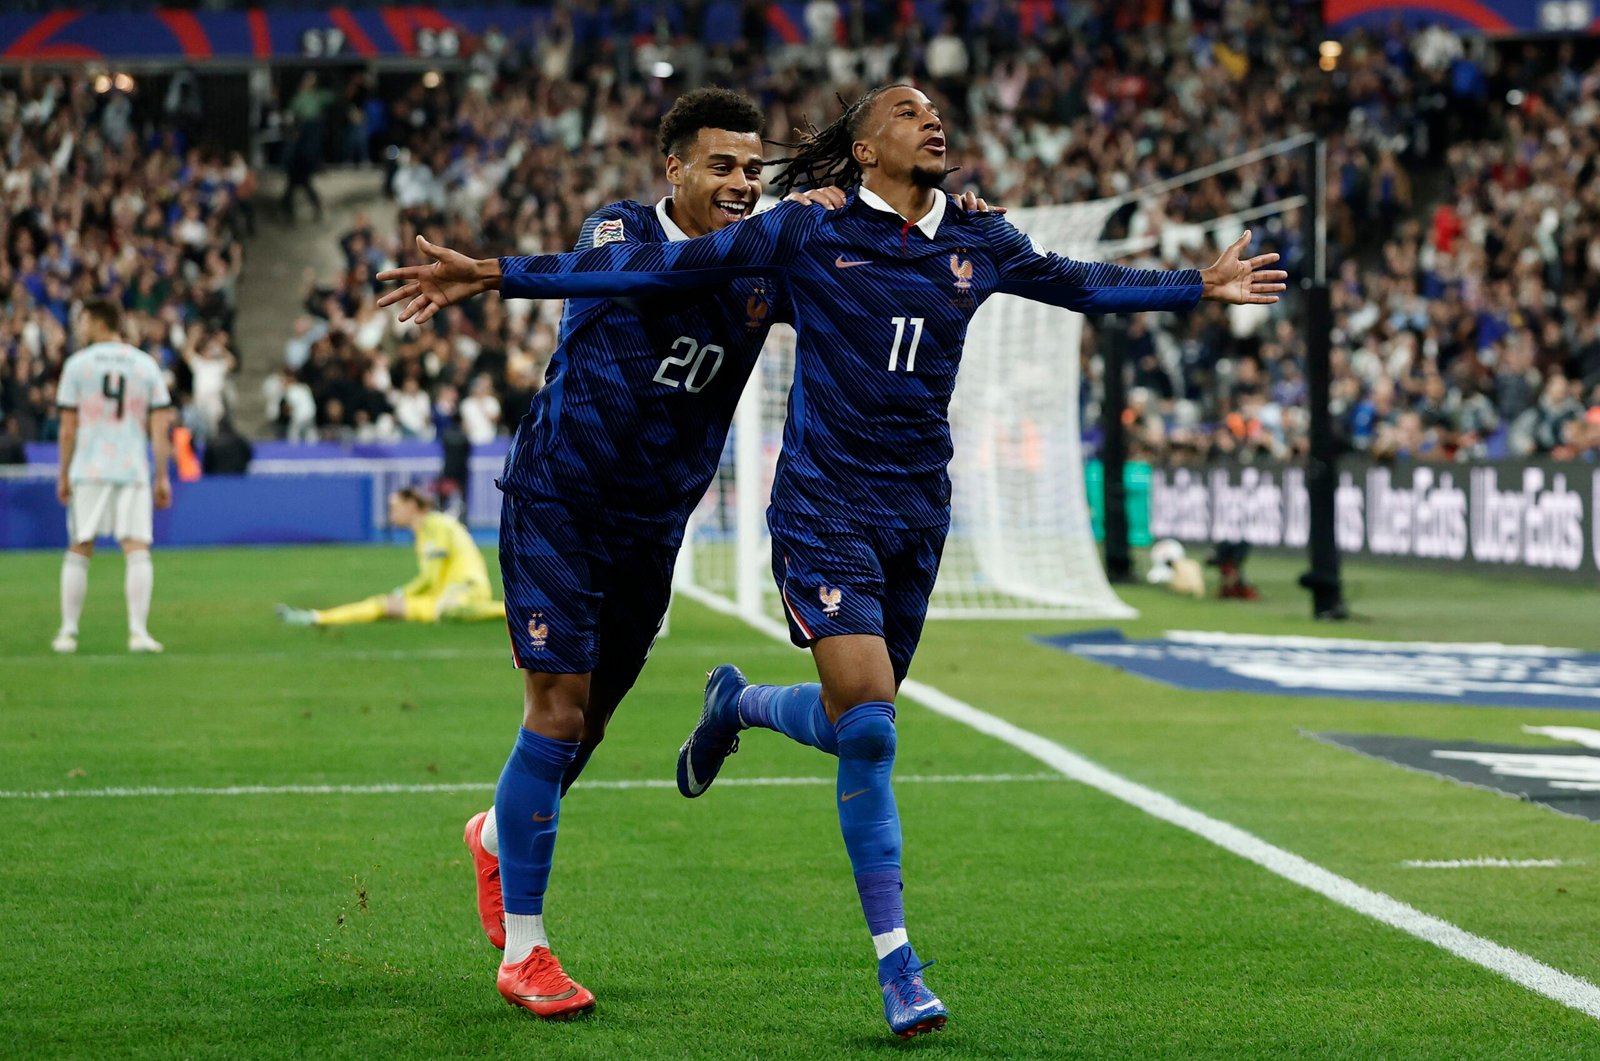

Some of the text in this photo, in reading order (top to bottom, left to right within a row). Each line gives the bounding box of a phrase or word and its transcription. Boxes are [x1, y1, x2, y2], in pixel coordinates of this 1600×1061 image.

[653, 336, 725, 393] 20
[888, 316, 925, 372] 11
[103, 371, 126, 420] 4
